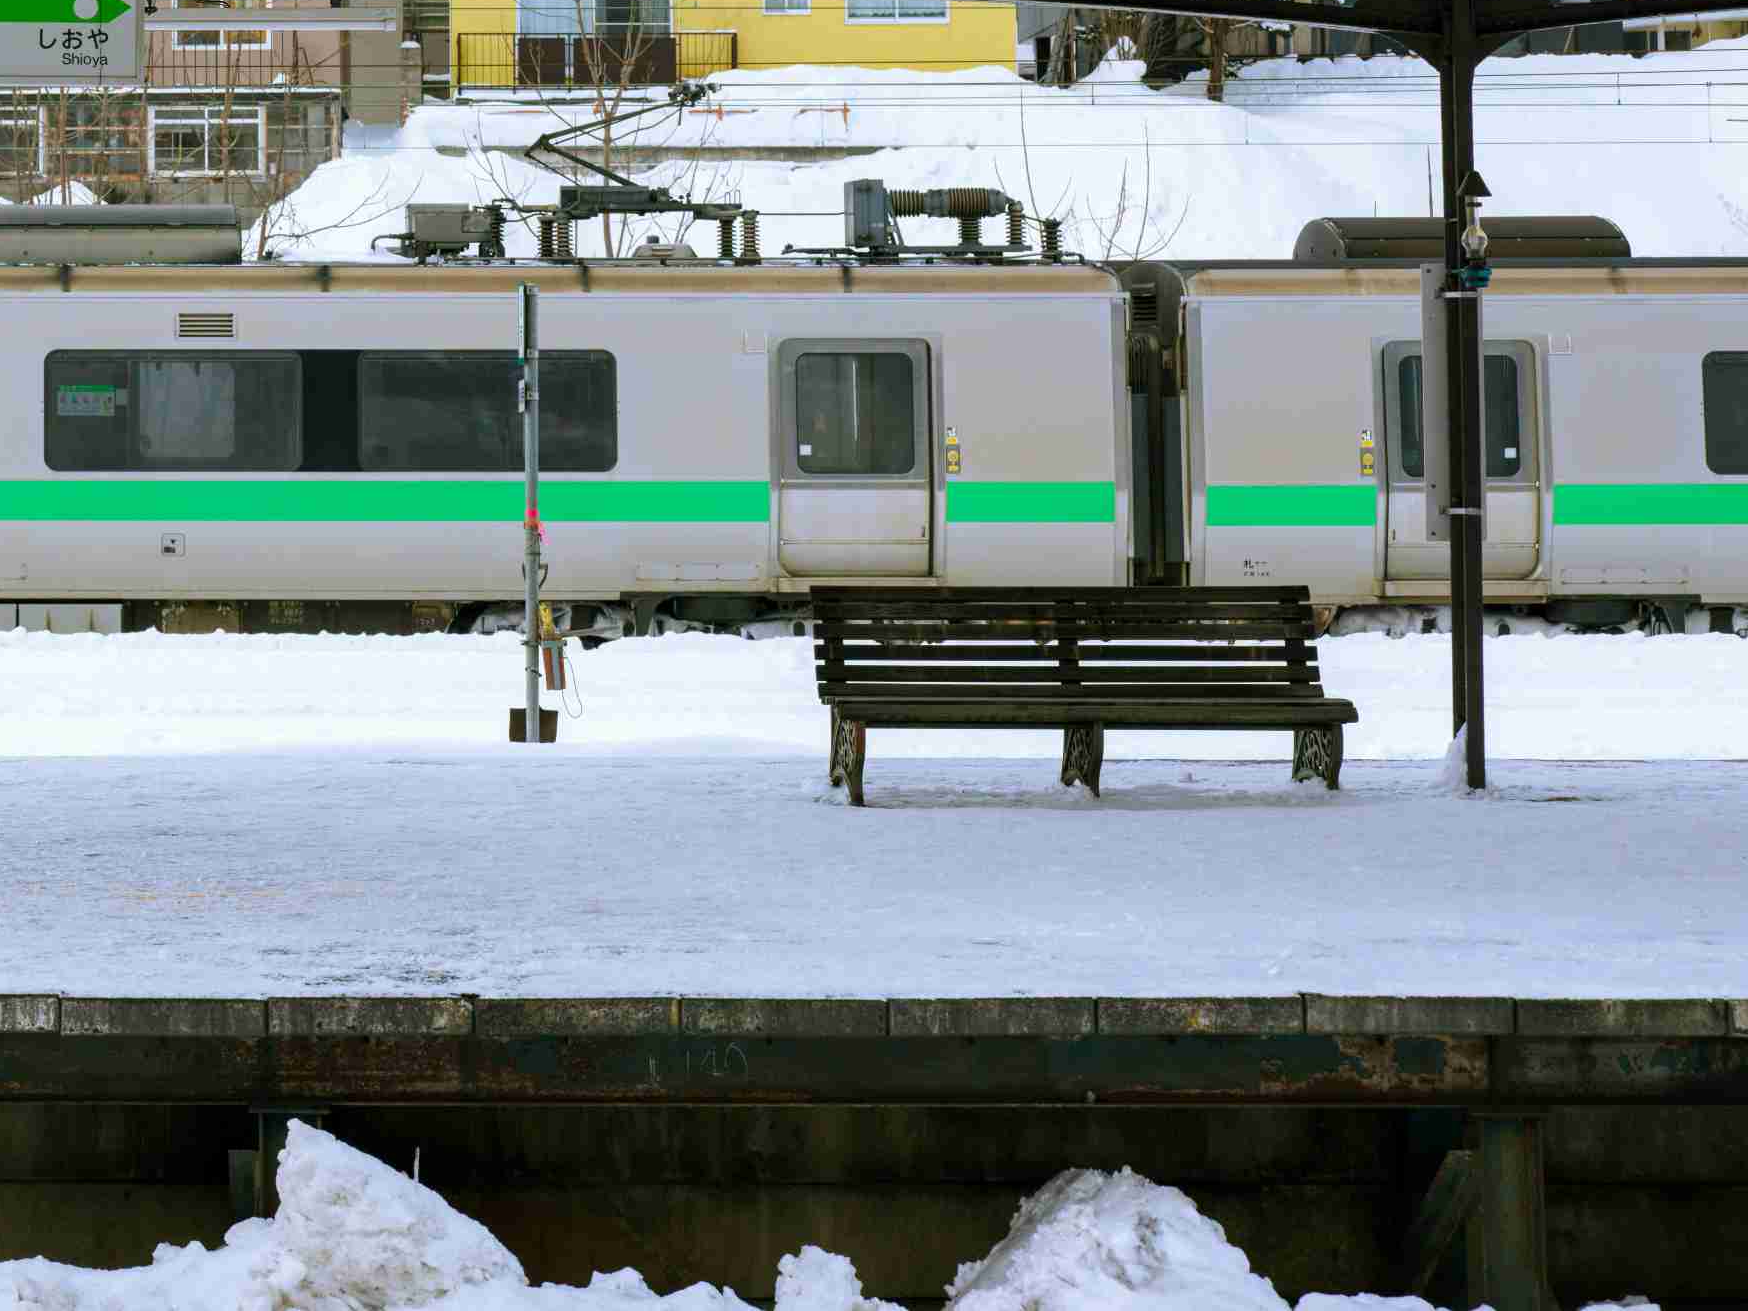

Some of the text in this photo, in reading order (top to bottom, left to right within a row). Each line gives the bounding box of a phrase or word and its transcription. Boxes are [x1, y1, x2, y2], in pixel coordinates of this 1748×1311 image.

[38, 24, 109, 50] しおや
[61, 51, 108, 68] Shioya
